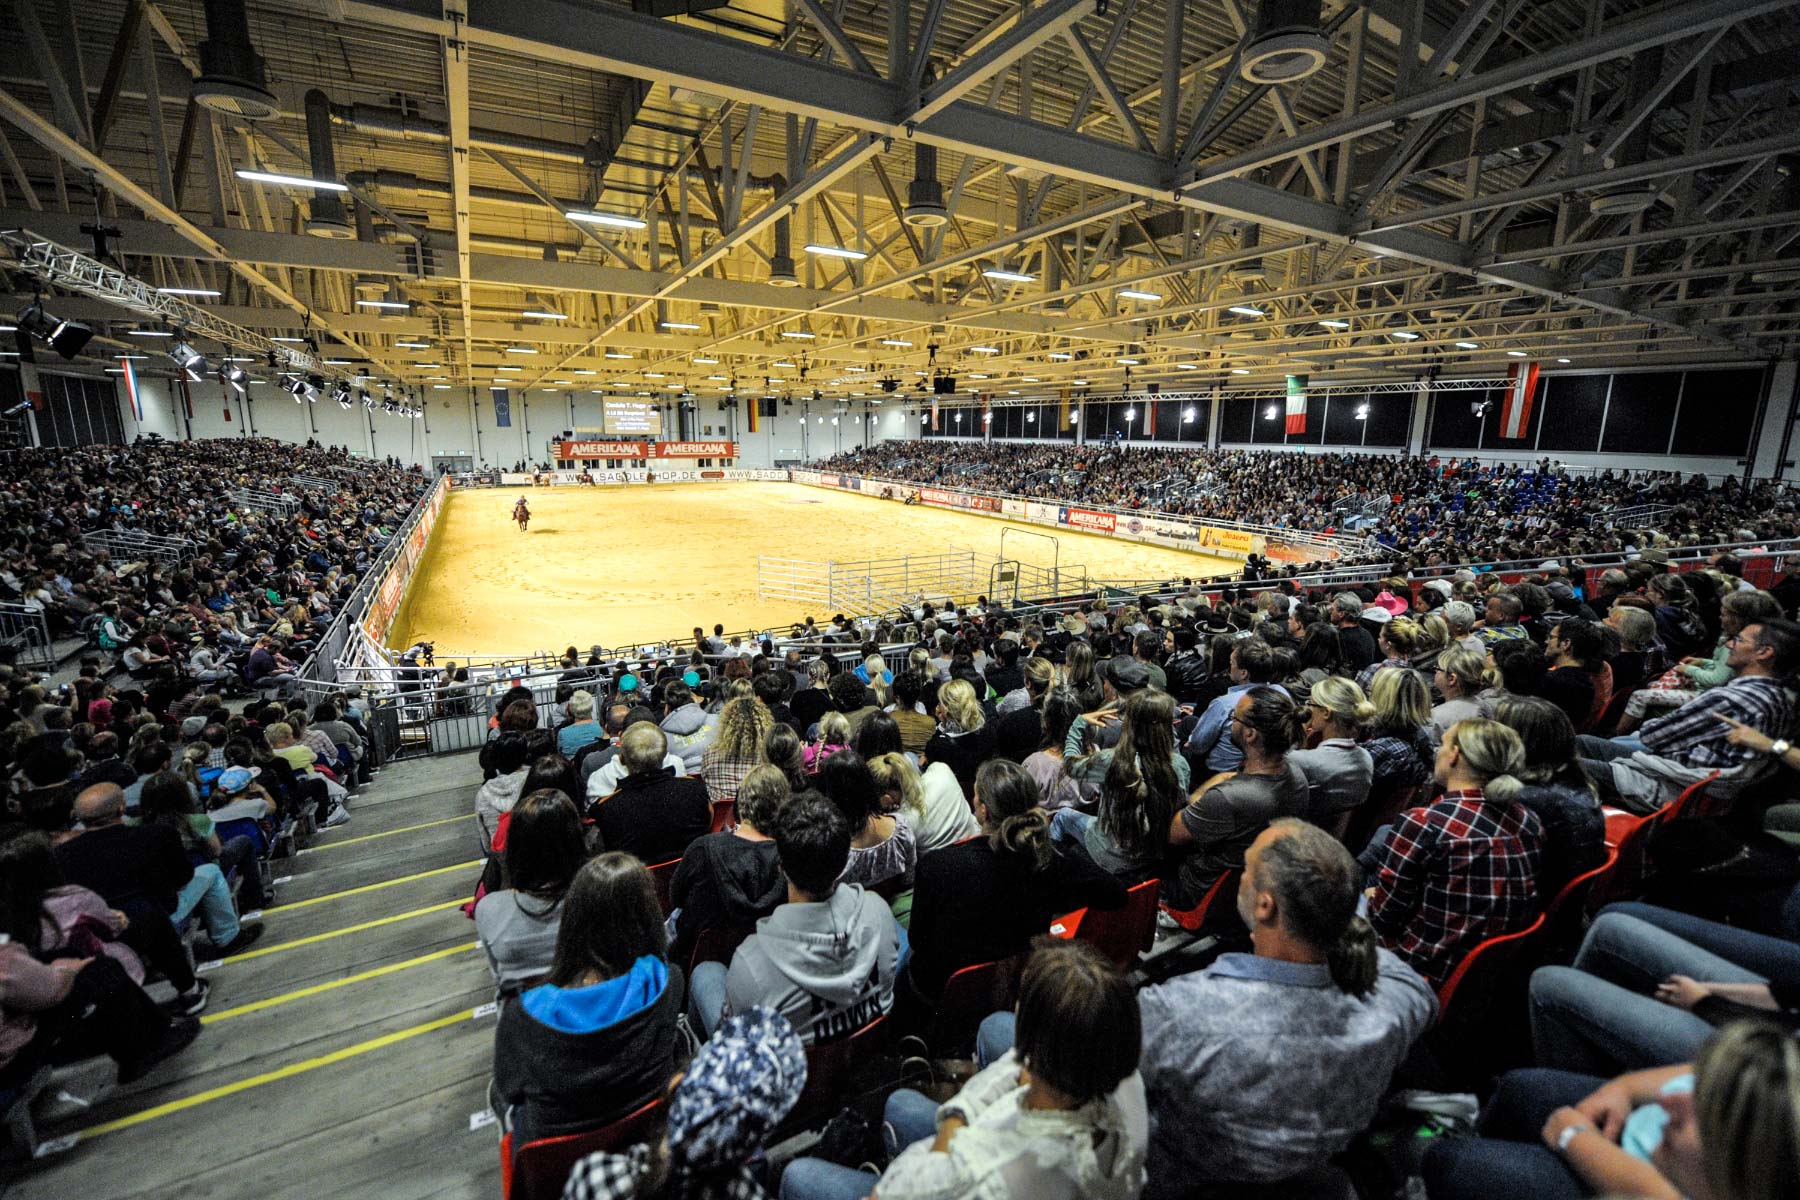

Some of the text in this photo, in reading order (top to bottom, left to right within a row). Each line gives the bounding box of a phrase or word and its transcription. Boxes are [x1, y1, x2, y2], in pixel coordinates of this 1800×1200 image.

[569, 443, 641, 456] AMERICANA
[663, 443, 727, 455] AMERICANA
[1068, 511, 1114, 529] AMERICANA
[1222, 531, 1249, 542] Josera
[814, 992, 882, 1045] DOWN
